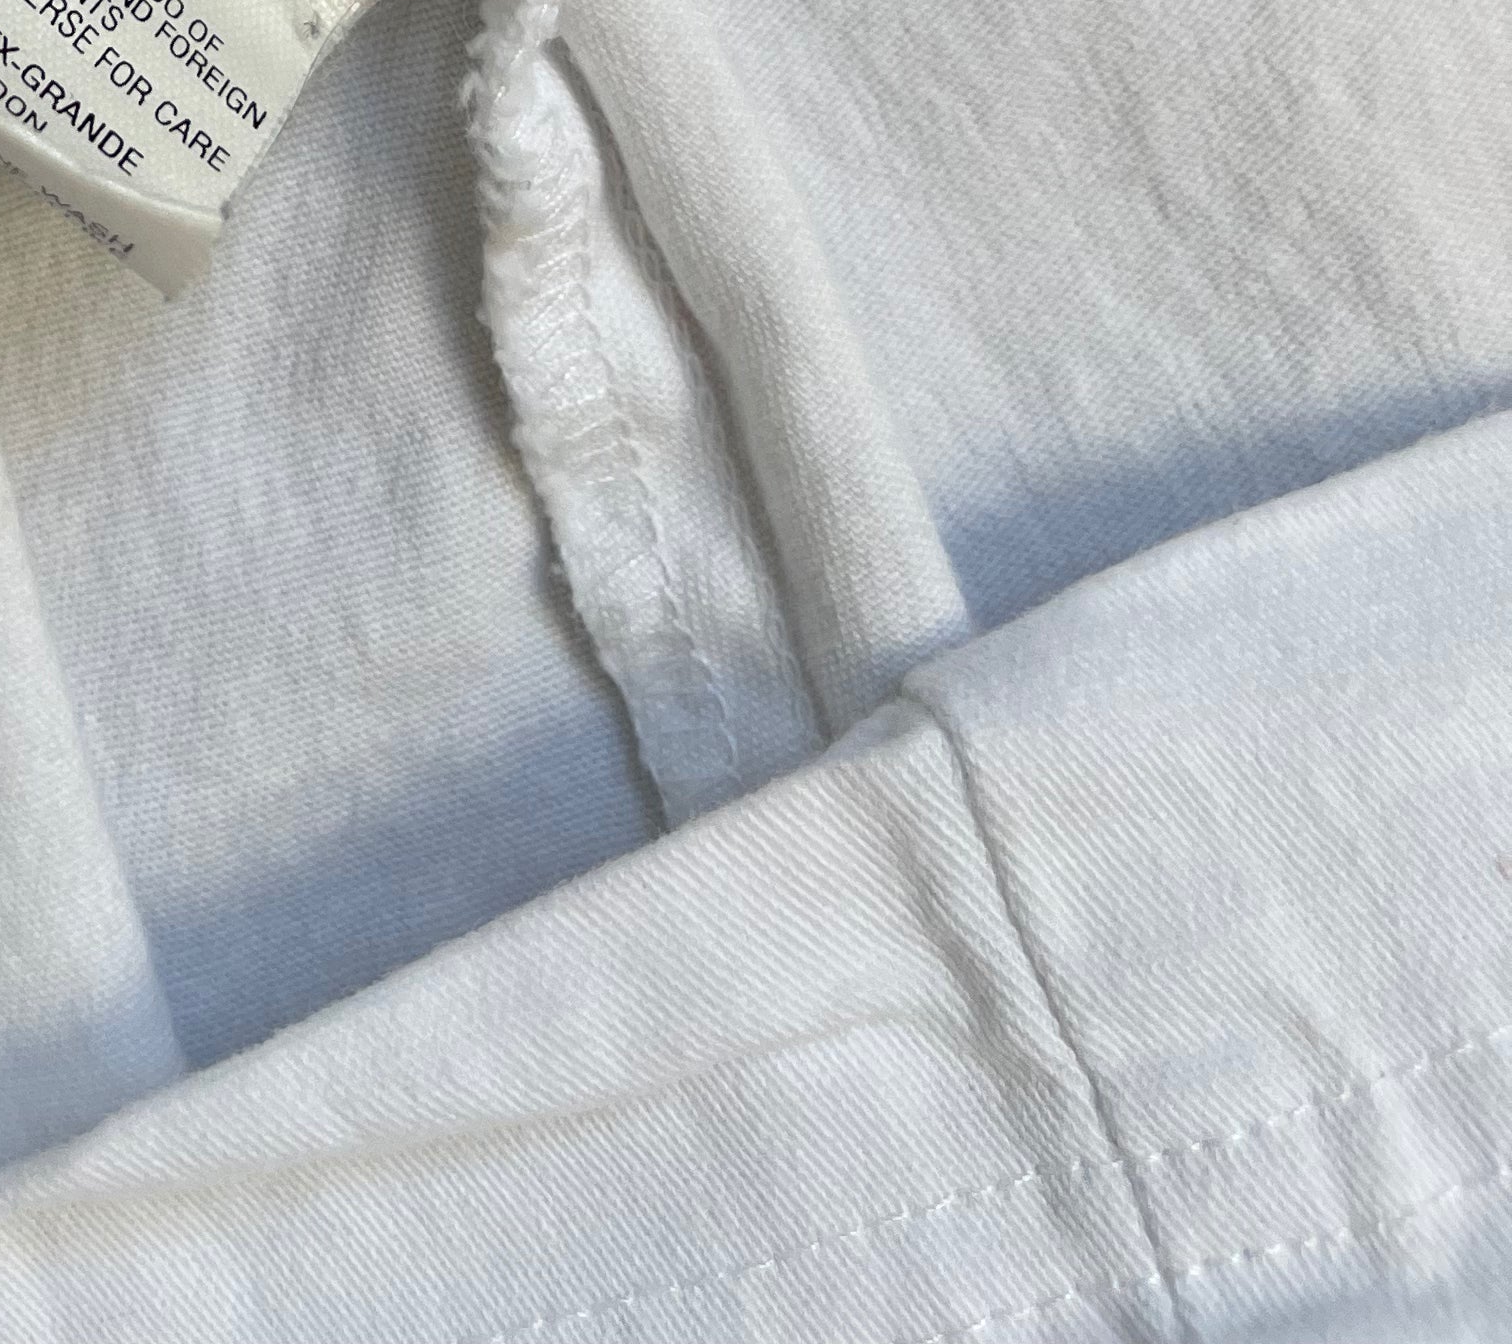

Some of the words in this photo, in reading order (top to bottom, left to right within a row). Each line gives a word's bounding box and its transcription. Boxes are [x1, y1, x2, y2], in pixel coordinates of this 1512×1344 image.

[155, 20, 267, 130] FOREIGN
[188, 19, 224, 51] OF
[94, 46, 153, 105] FOR
[155, 101, 231, 172] CARE
